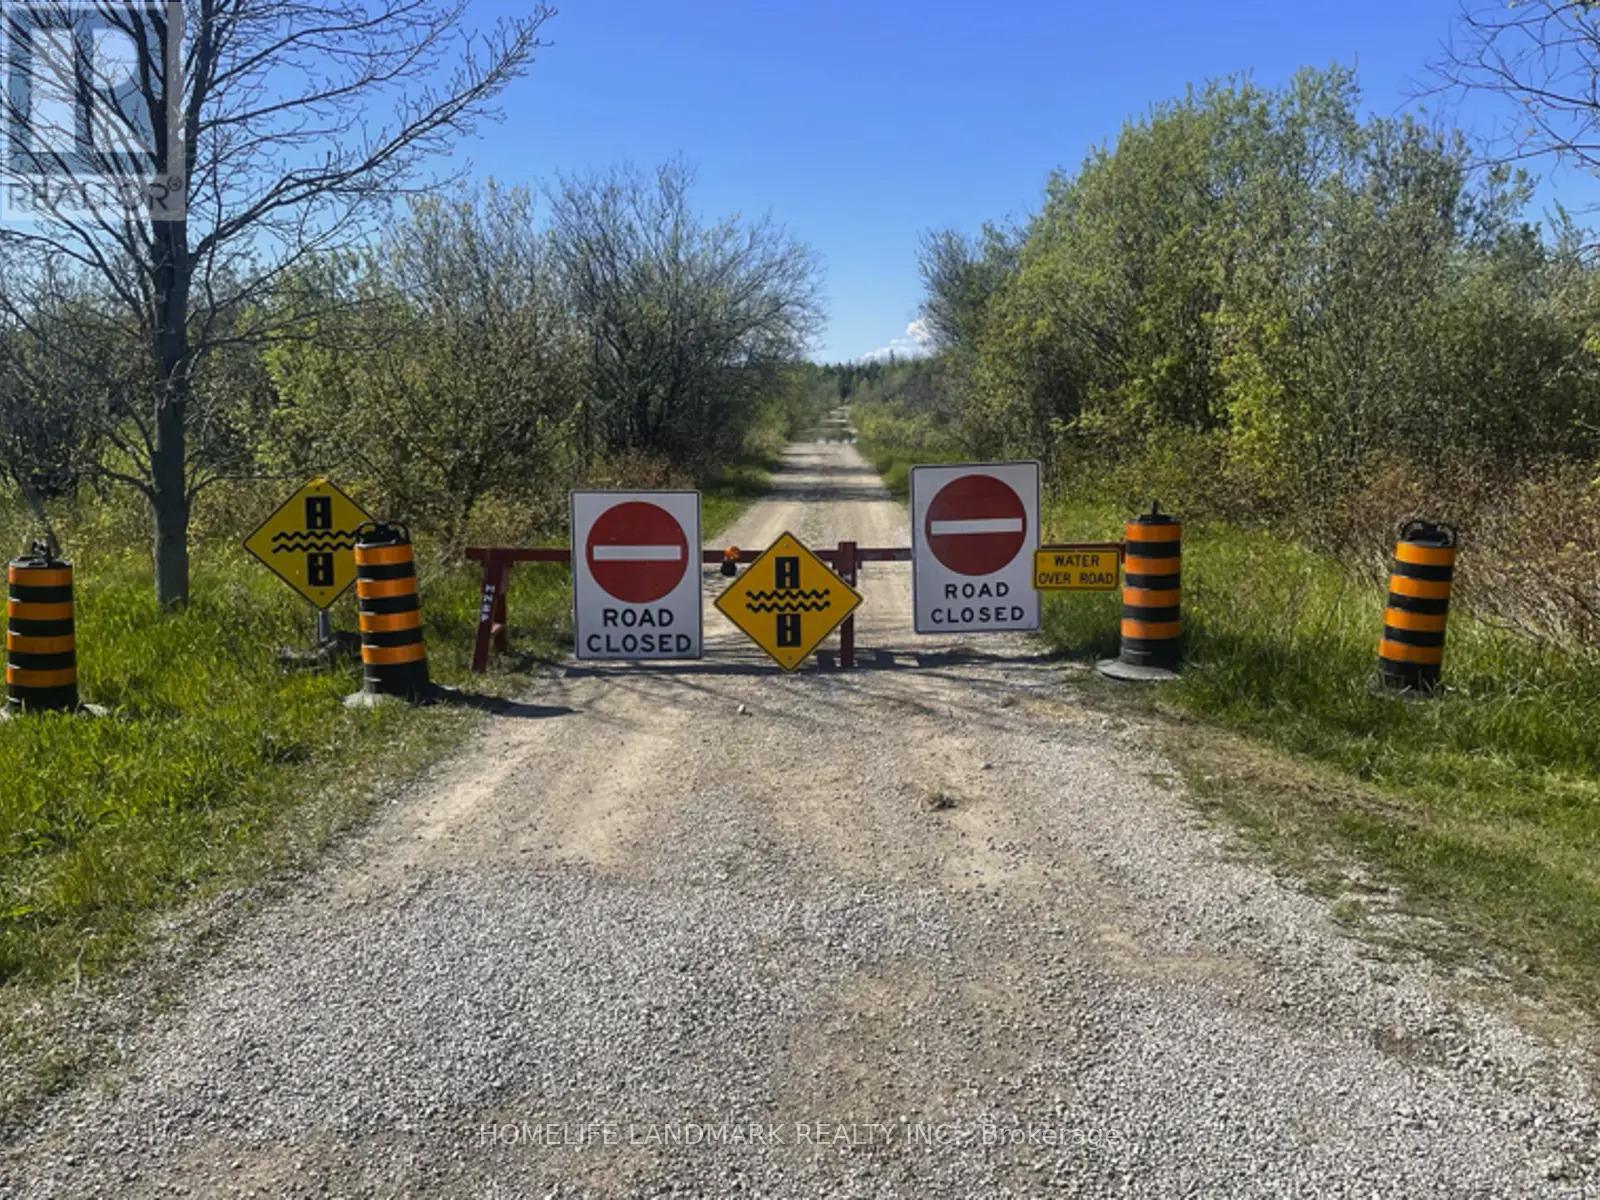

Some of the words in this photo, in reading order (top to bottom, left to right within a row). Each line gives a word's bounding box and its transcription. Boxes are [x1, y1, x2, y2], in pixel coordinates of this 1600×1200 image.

[1055, 555, 1100, 567] WATER
[1038, 572, 1071, 584] OVER
[1079, 572, 1114, 584] ROAD
[944, 581, 1010, 599] ROAD
[602, 608, 674, 628] ROAD
[931, 606, 1025, 624] CLOSED
[586, 633, 692, 653] CLOSED
